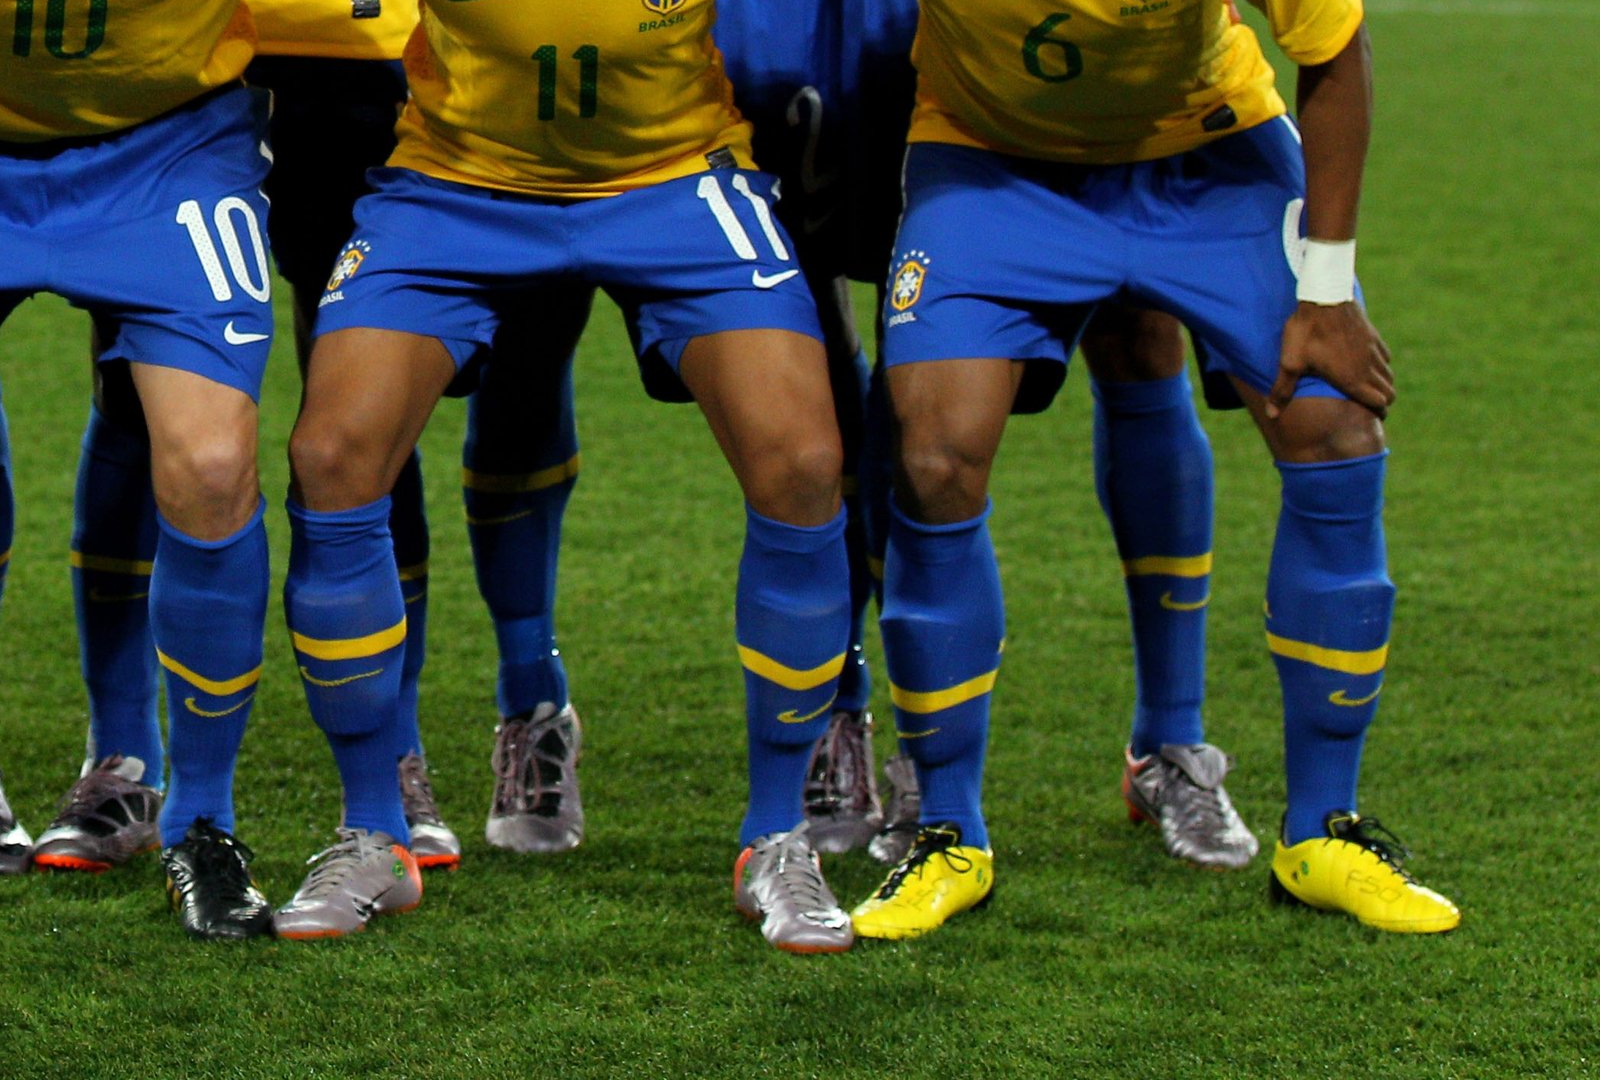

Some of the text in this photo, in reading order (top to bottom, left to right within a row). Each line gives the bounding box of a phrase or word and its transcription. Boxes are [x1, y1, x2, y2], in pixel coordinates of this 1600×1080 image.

[638, 13, 688, 33] BRASIL
[1022, 12, 1084, 84] 6
[531, 44, 599, 121] 11
[175, 196, 271, 304] 10
[696, 173, 791, 261] 11
